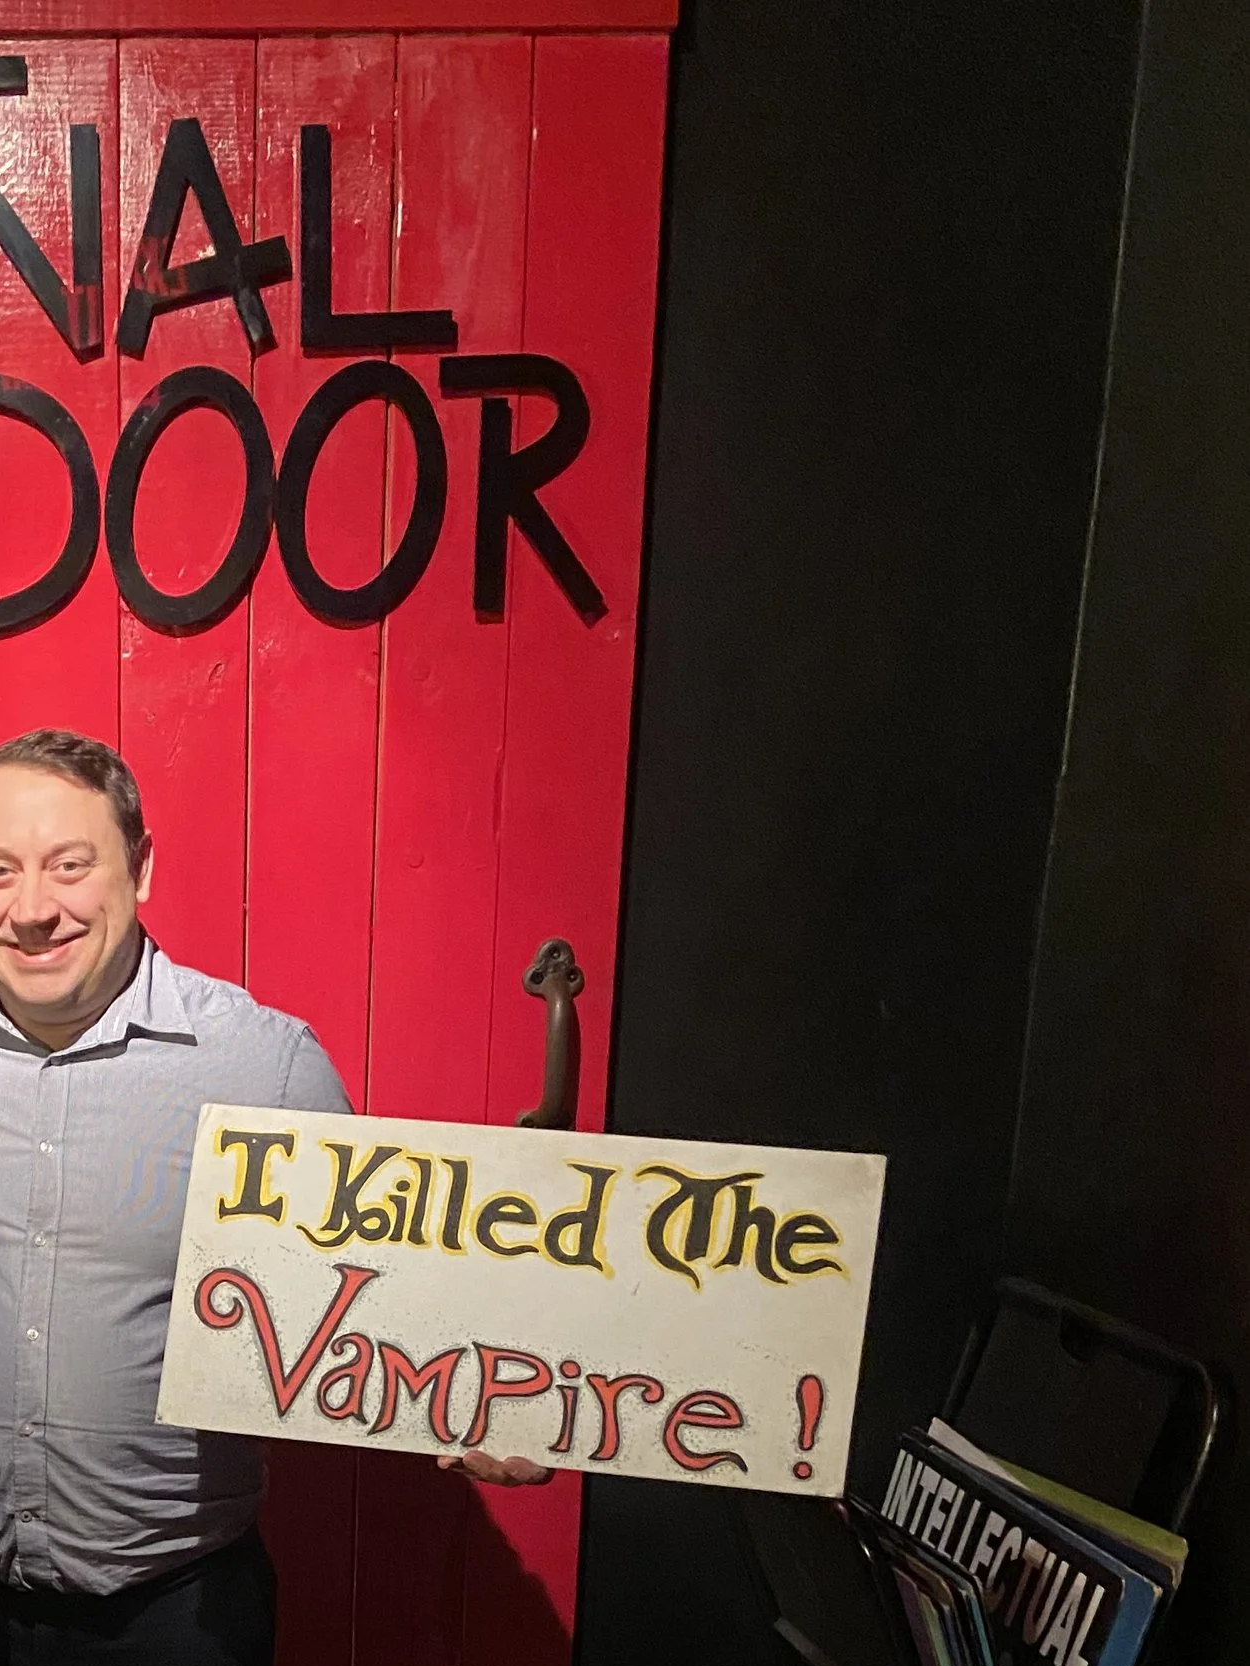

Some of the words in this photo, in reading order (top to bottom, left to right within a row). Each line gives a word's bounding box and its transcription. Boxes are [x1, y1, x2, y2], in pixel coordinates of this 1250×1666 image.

[220, 1130, 296, 1220] I
[296, 1141, 617, 1272] Killed
[636, 1162, 843, 1290] The
